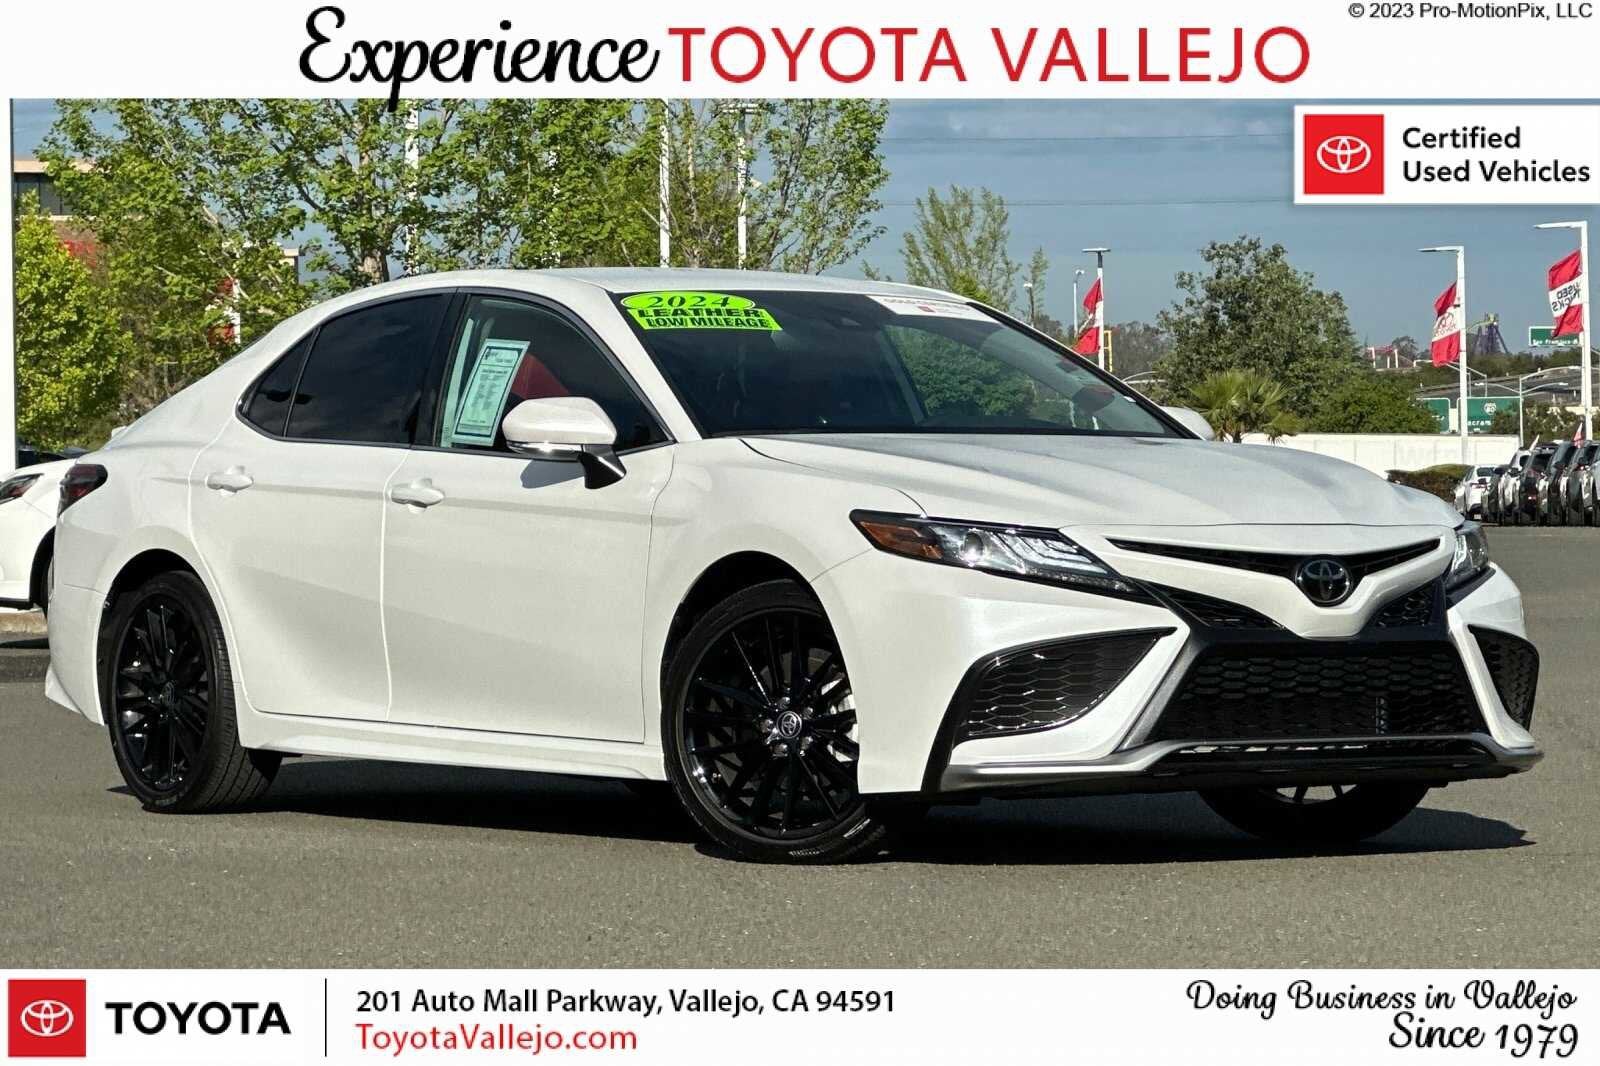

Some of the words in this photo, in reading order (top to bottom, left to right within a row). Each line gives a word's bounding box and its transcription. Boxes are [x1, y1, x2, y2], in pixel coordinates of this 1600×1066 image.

[647, 295, 731, 308] 2024
[639, 307, 762, 318] LEATHER
[647, 317, 688, 328] LOW
[691, 317, 770, 328] MILEAGE
